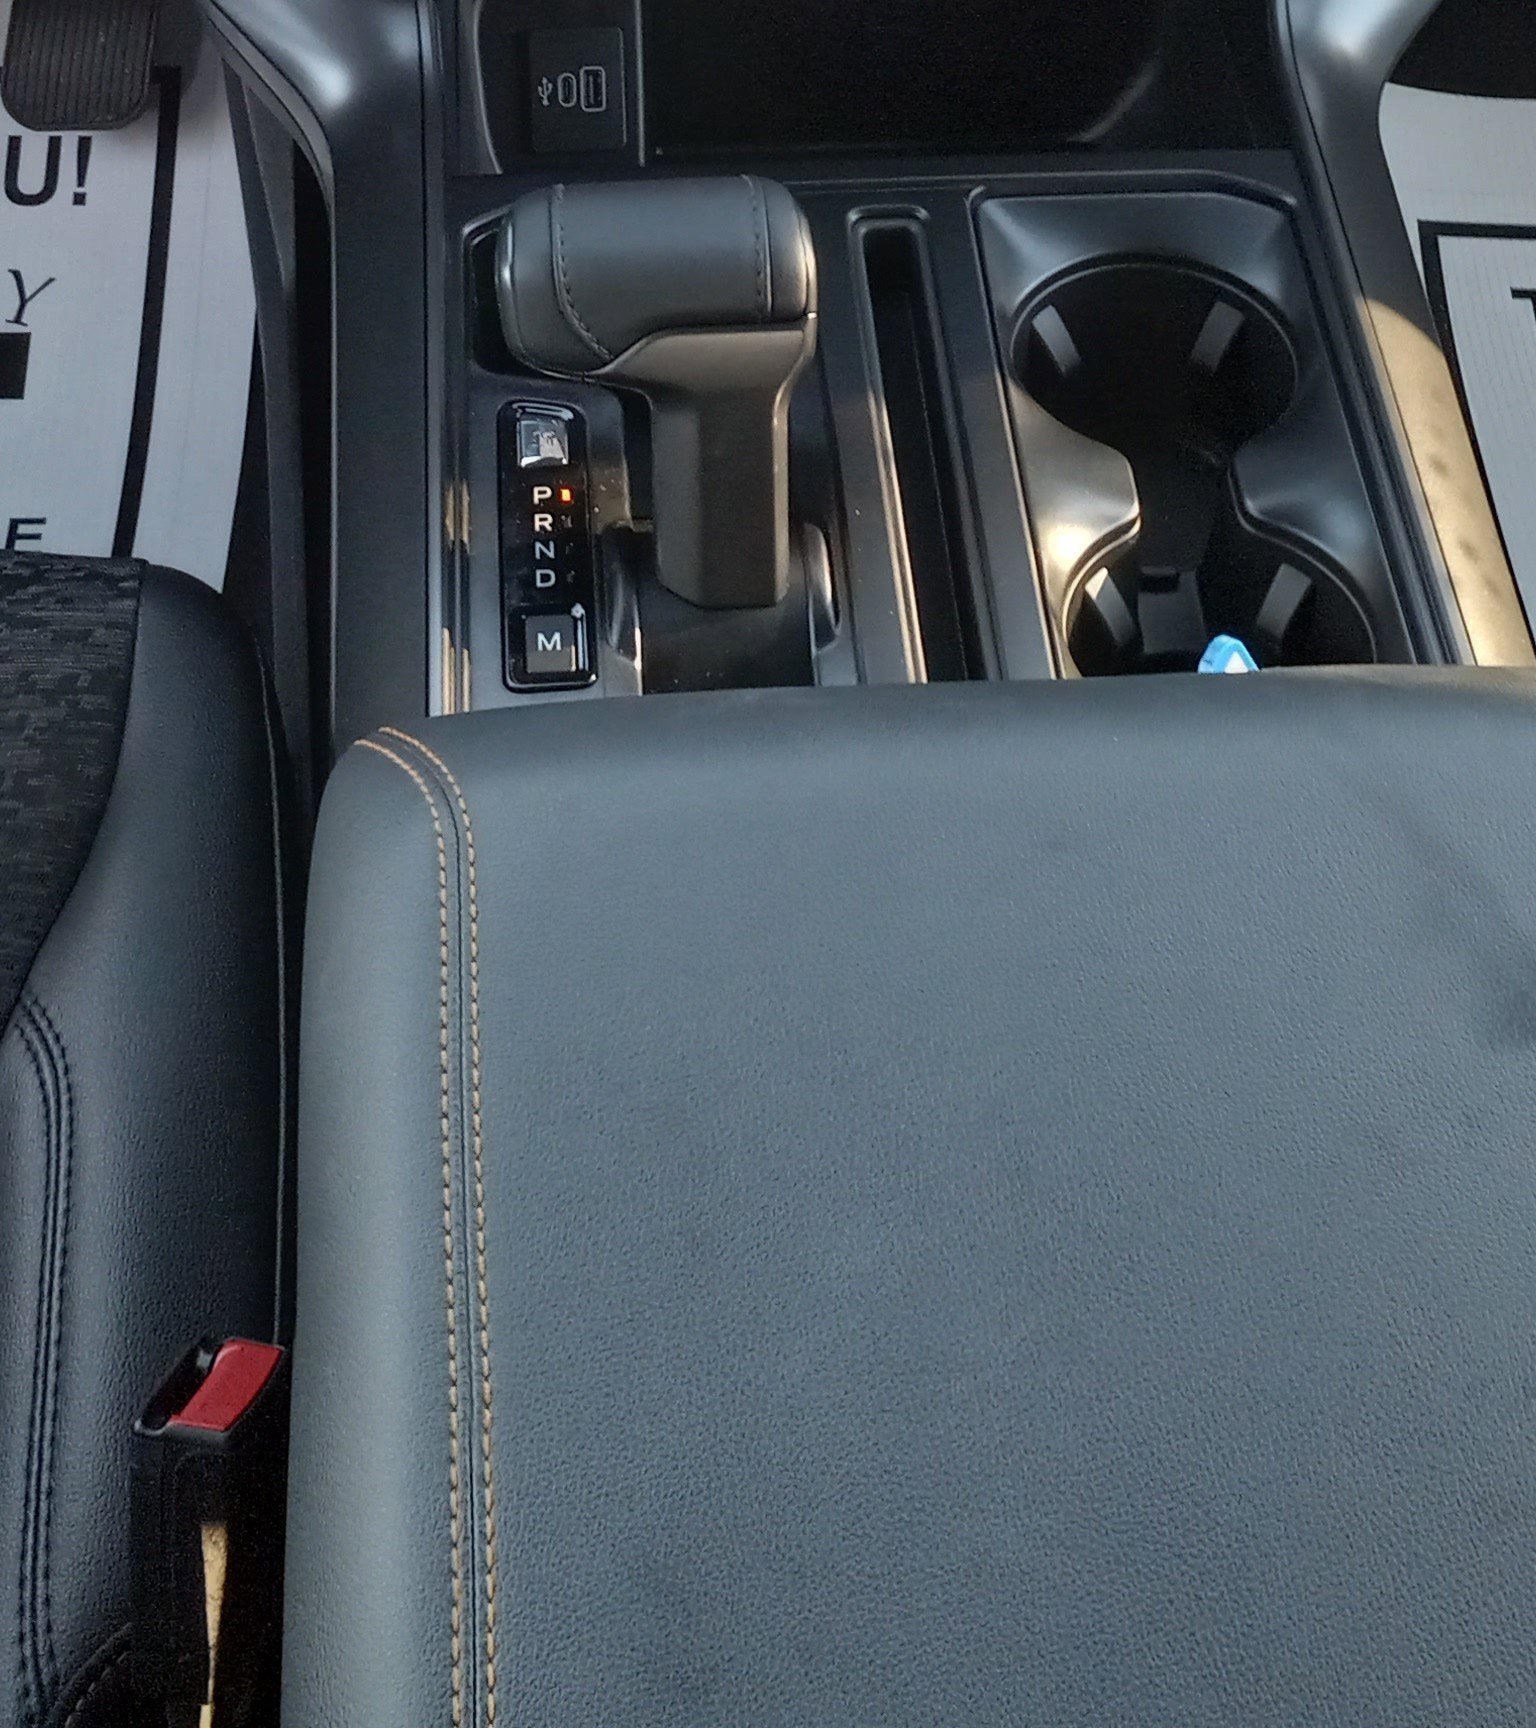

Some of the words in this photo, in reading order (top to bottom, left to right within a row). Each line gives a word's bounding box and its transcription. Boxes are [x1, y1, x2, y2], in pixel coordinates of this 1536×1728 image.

[532, 485, 553, 505] P
[534, 512, 554, 532] R
[535, 541, 556, 560] N
[536, 569, 556, 588] D
[537, 632, 562, 652] M
